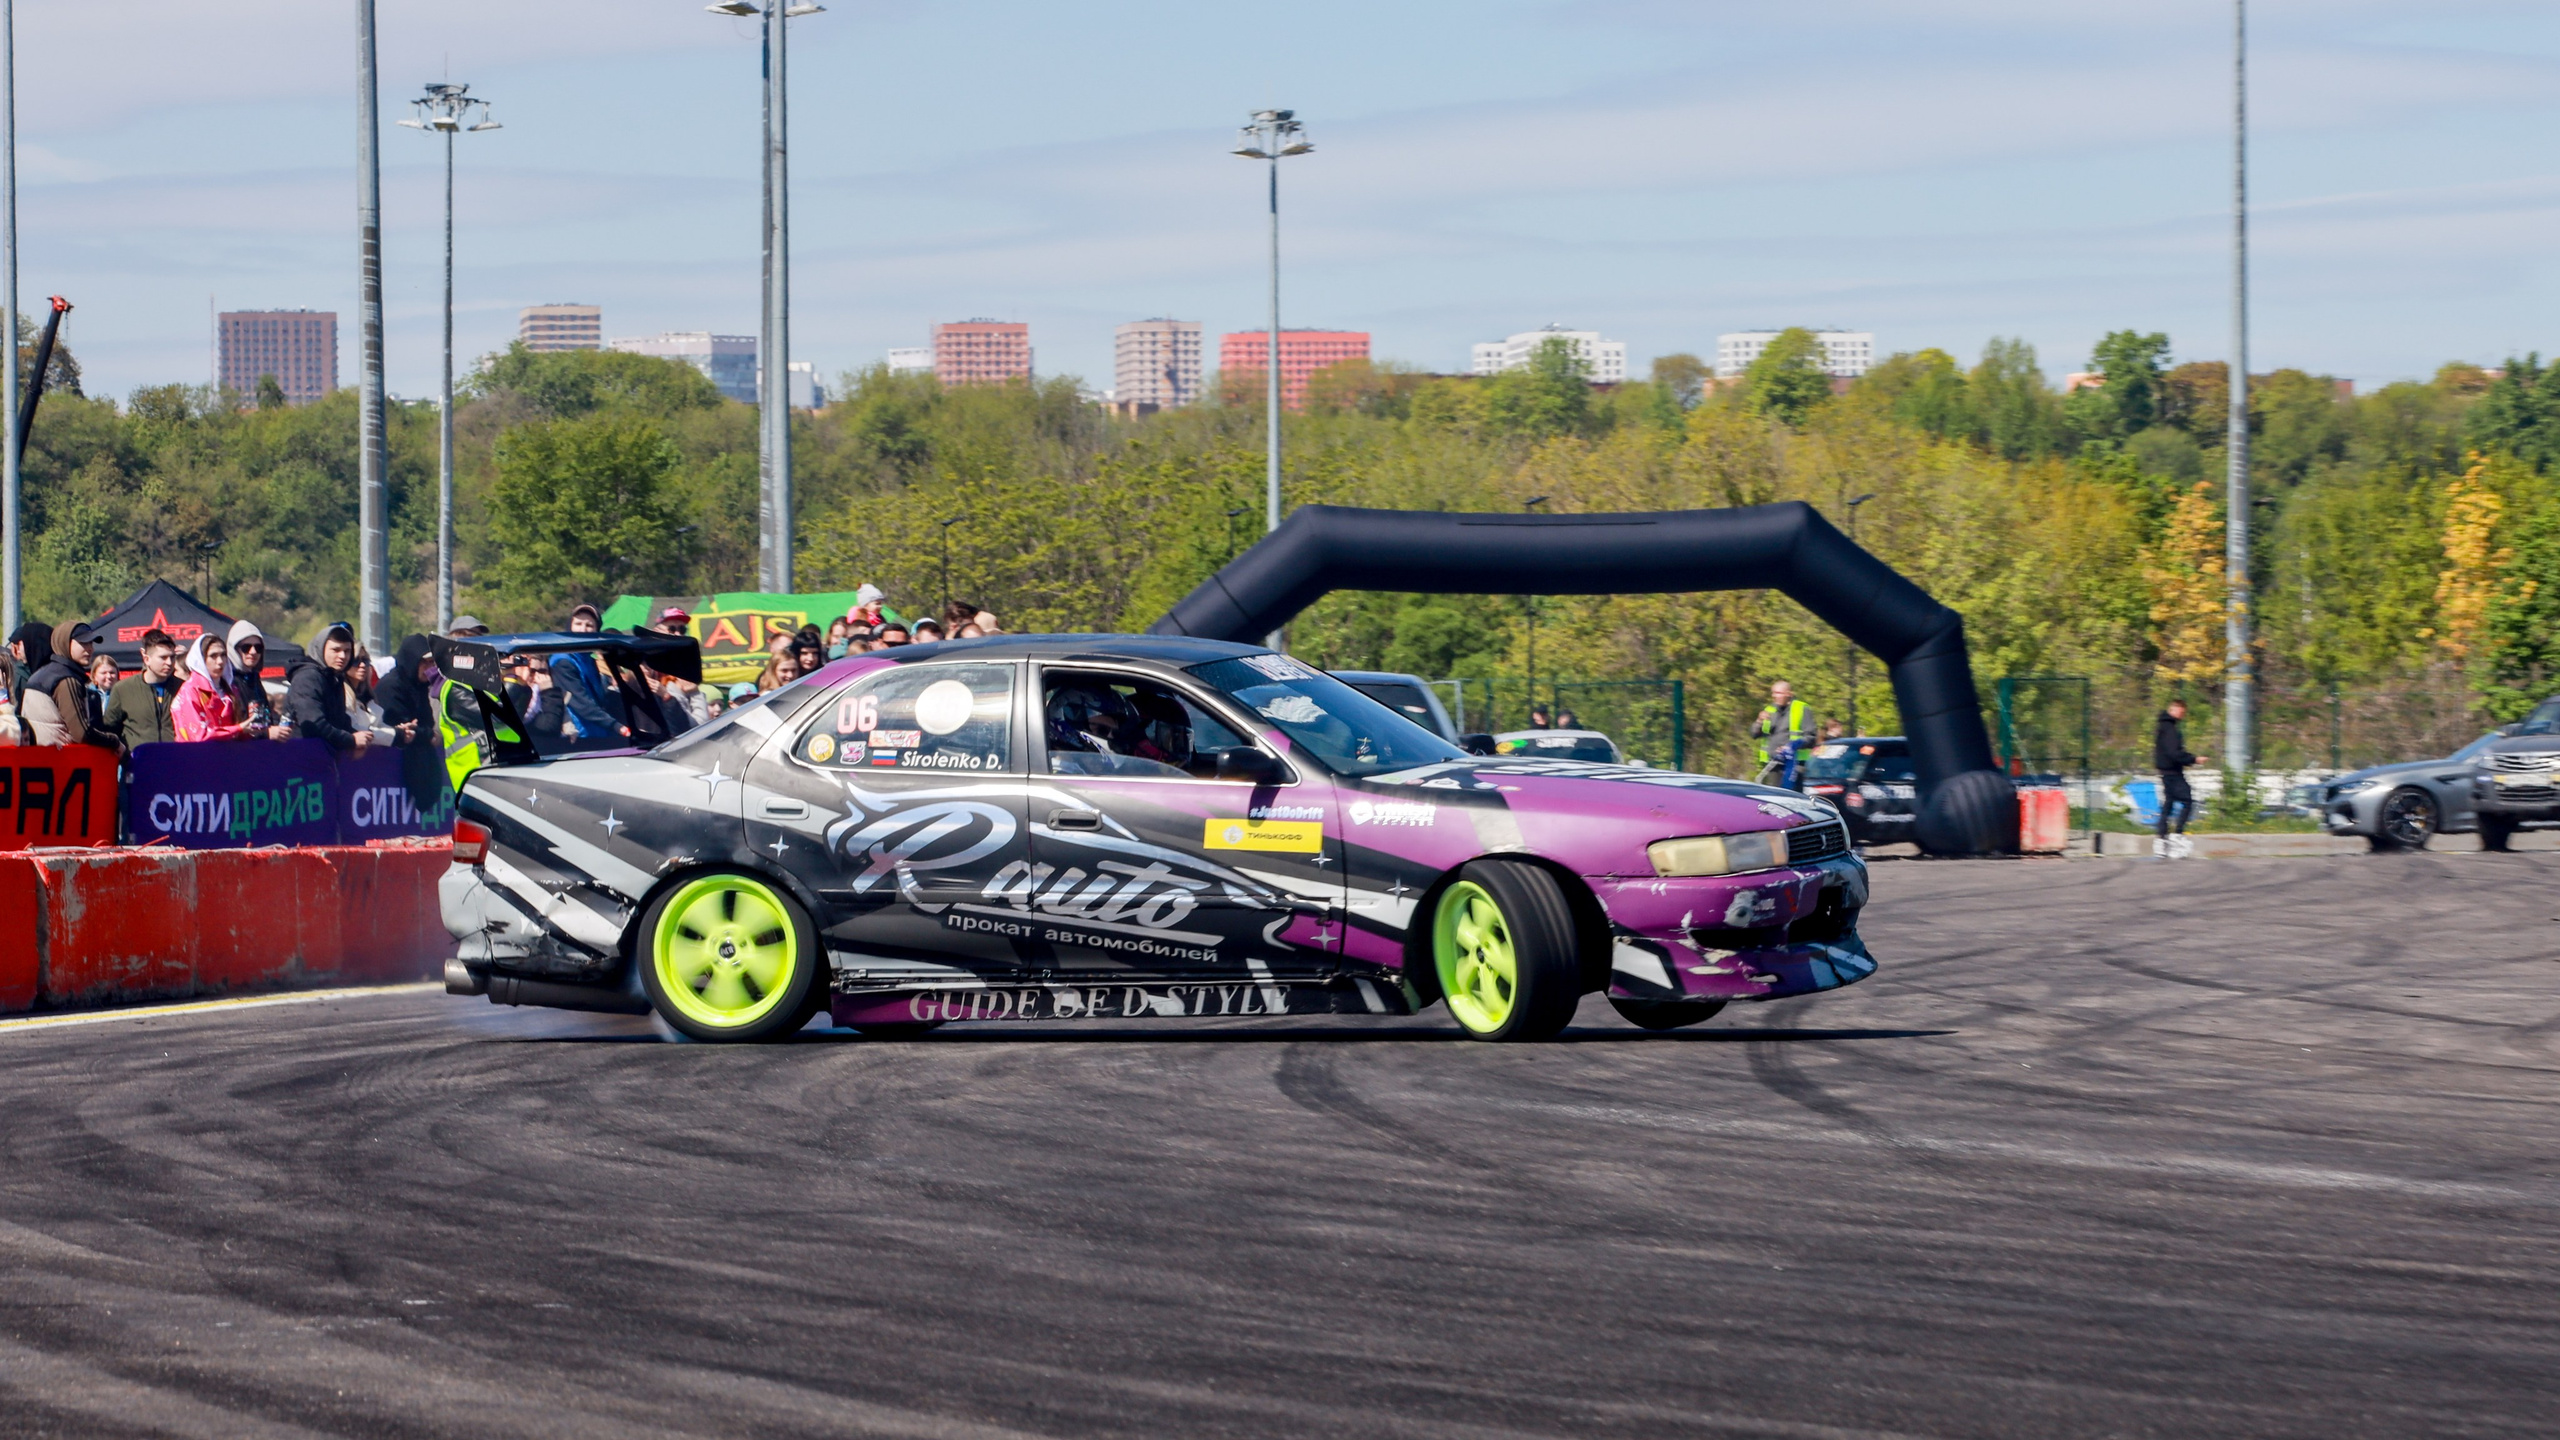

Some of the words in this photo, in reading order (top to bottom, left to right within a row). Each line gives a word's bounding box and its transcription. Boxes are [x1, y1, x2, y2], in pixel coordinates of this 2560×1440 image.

[837, 695, 878, 734] 06
[902, 751, 981, 769] Sirotenko
[985, 754, 1002, 770] D.
[149, 778, 324, 839] СИТИДРАЙВ
[1248, 832, 1302, 841] ТИНЬКОФФ
[948, 913, 1033, 937] прокат
[1045, 928, 1218, 962] автомобилей
[910, 988, 1041, 1021] GUIDE
[1053, 987, 1110, 1018] OF
